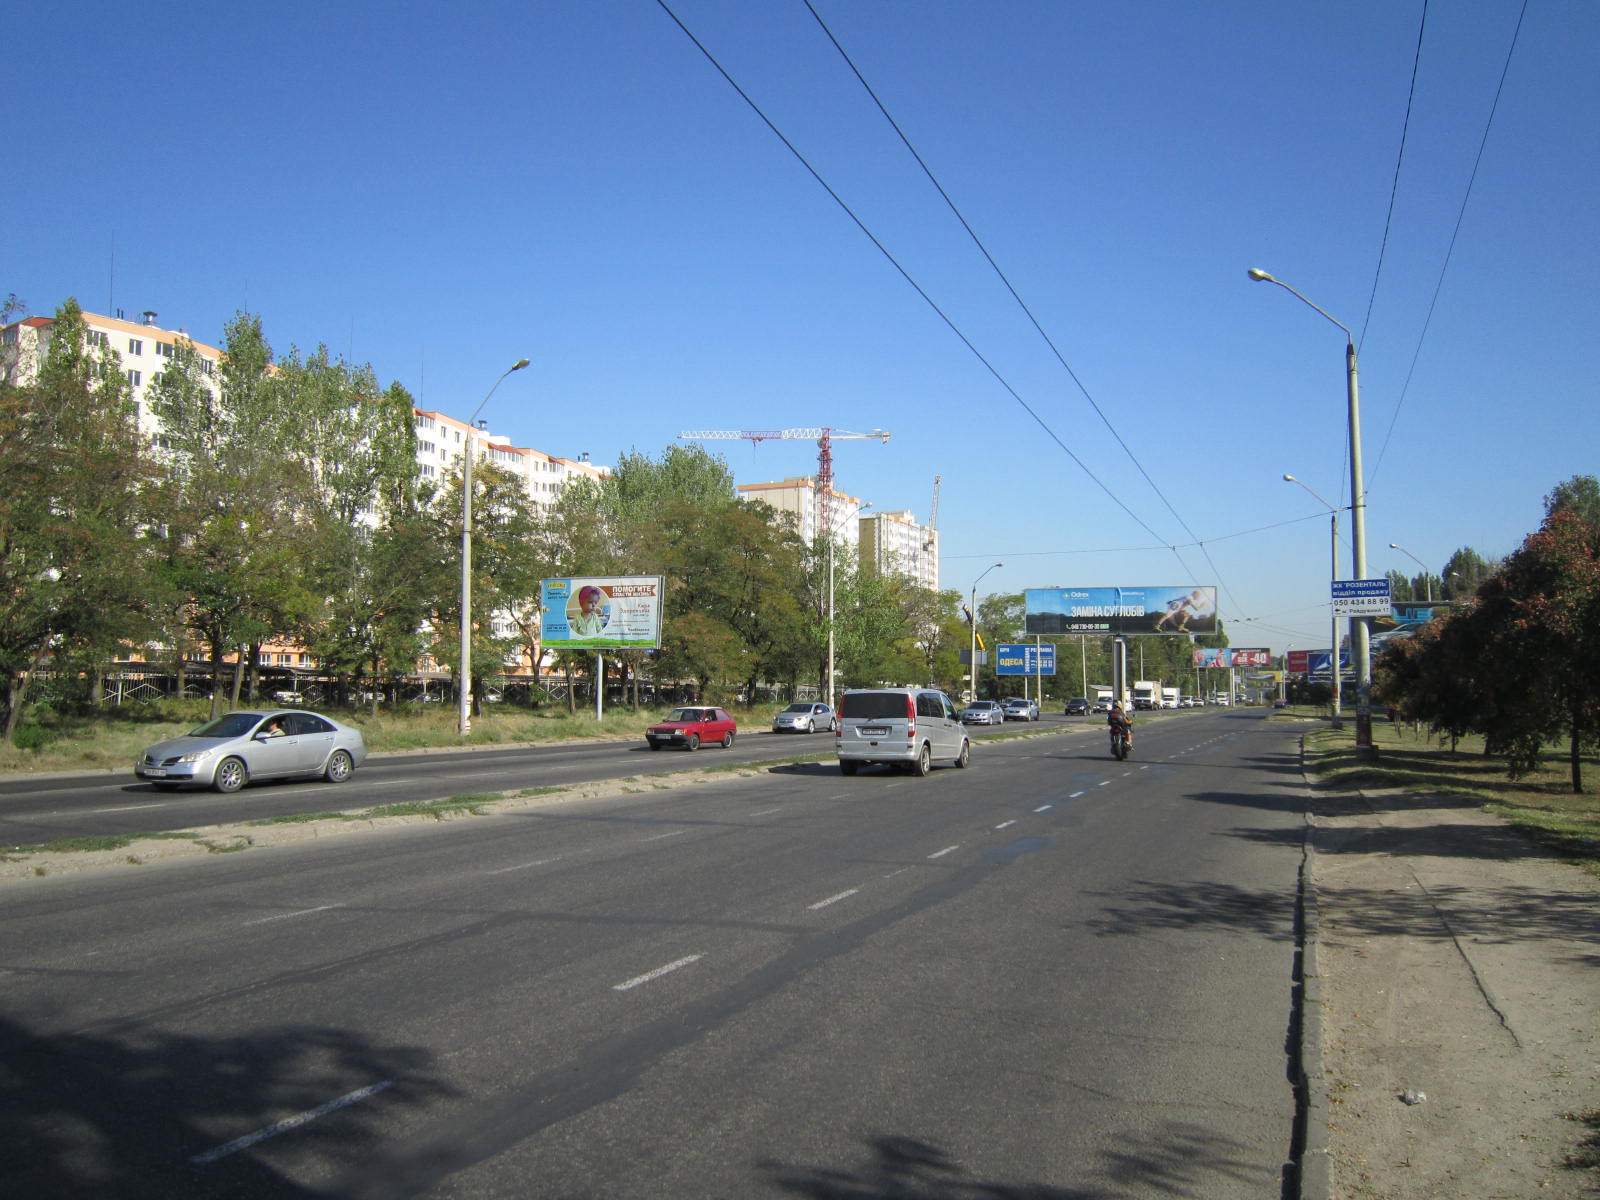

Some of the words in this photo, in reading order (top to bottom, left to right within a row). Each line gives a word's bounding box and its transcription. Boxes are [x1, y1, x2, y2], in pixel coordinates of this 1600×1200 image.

[612, 585, 651, 593] ПОМОГИТЕ
[1071, 606, 1104, 617] ЗАМІНА
[1104, 605, 1145, 617] СУГЛОБІВ
